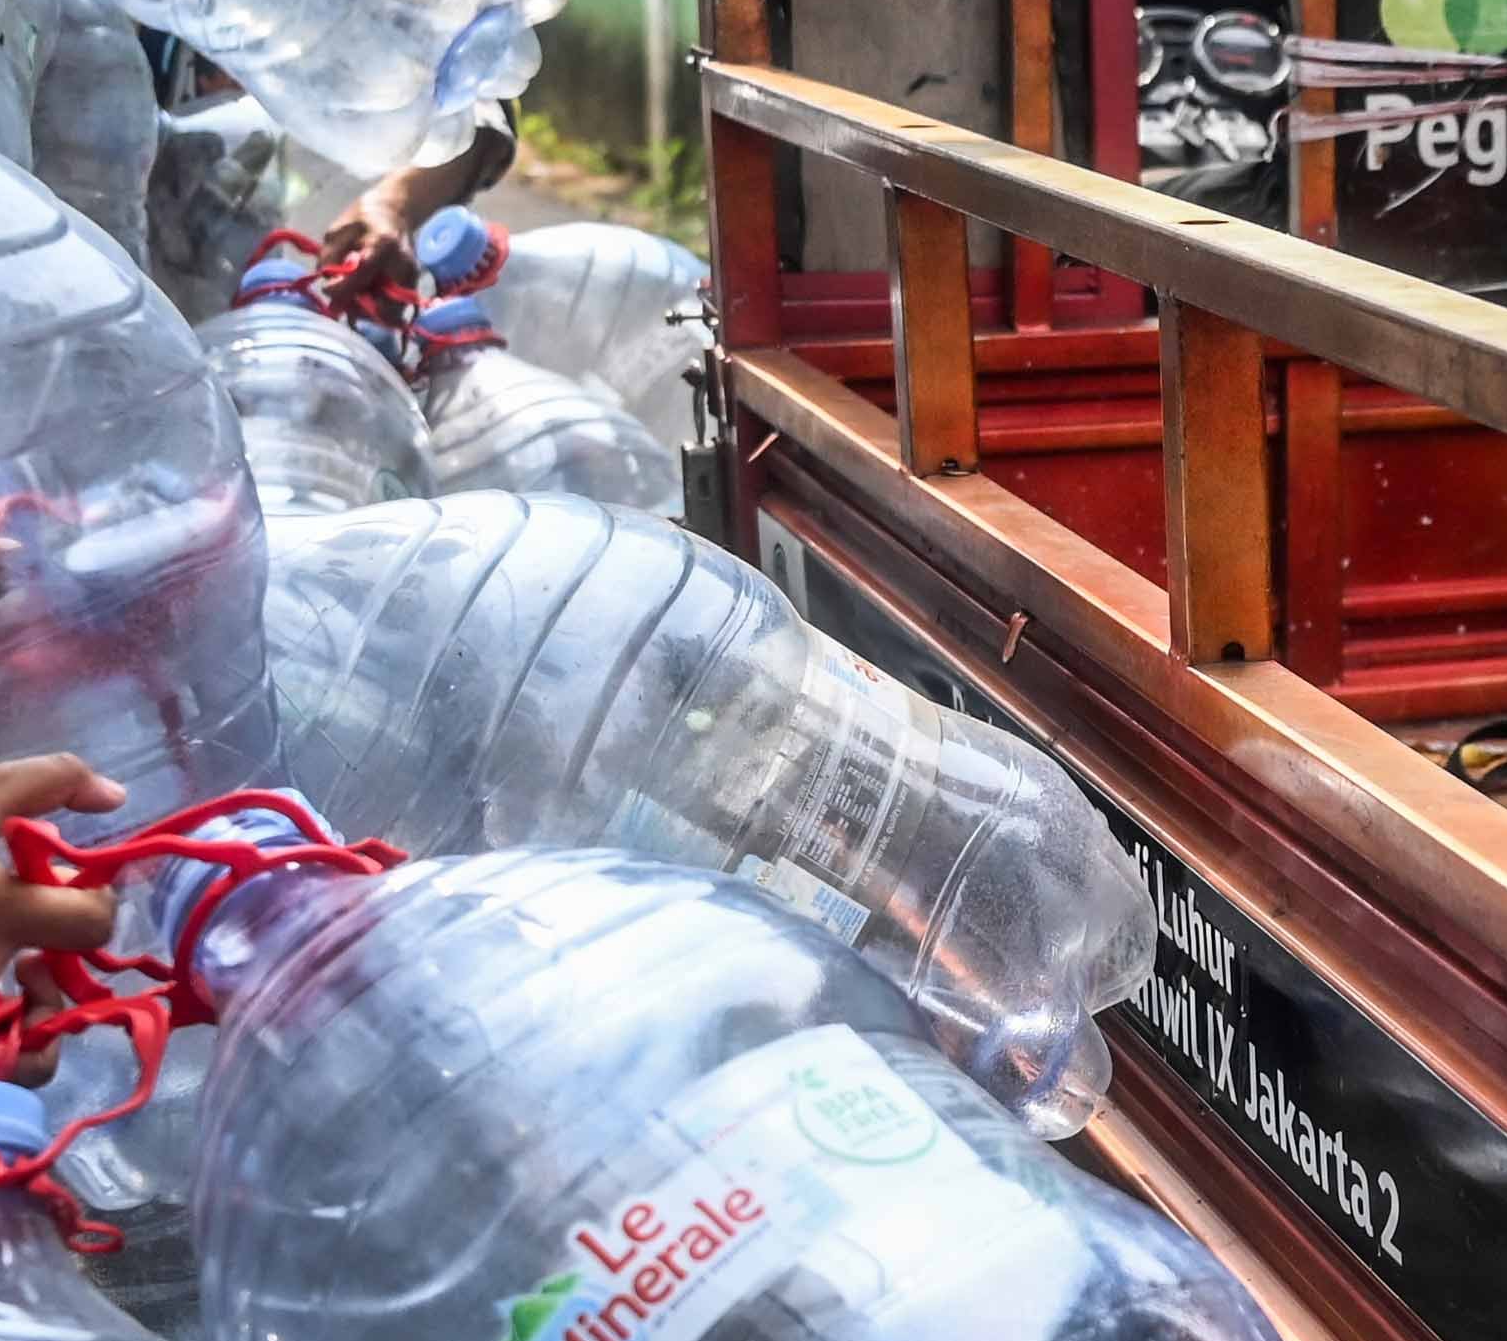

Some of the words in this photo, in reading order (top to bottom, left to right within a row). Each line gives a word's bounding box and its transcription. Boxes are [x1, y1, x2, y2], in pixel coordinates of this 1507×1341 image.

[1156, 860, 1235, 996] Luhur
[1206, 1003, 1238, 1105] IX
[1245, 1041, 1374, 1237] Jakarta
[1378, 1171, 1403, 1267] 2
[576, 1202, 666, 1275] Le
